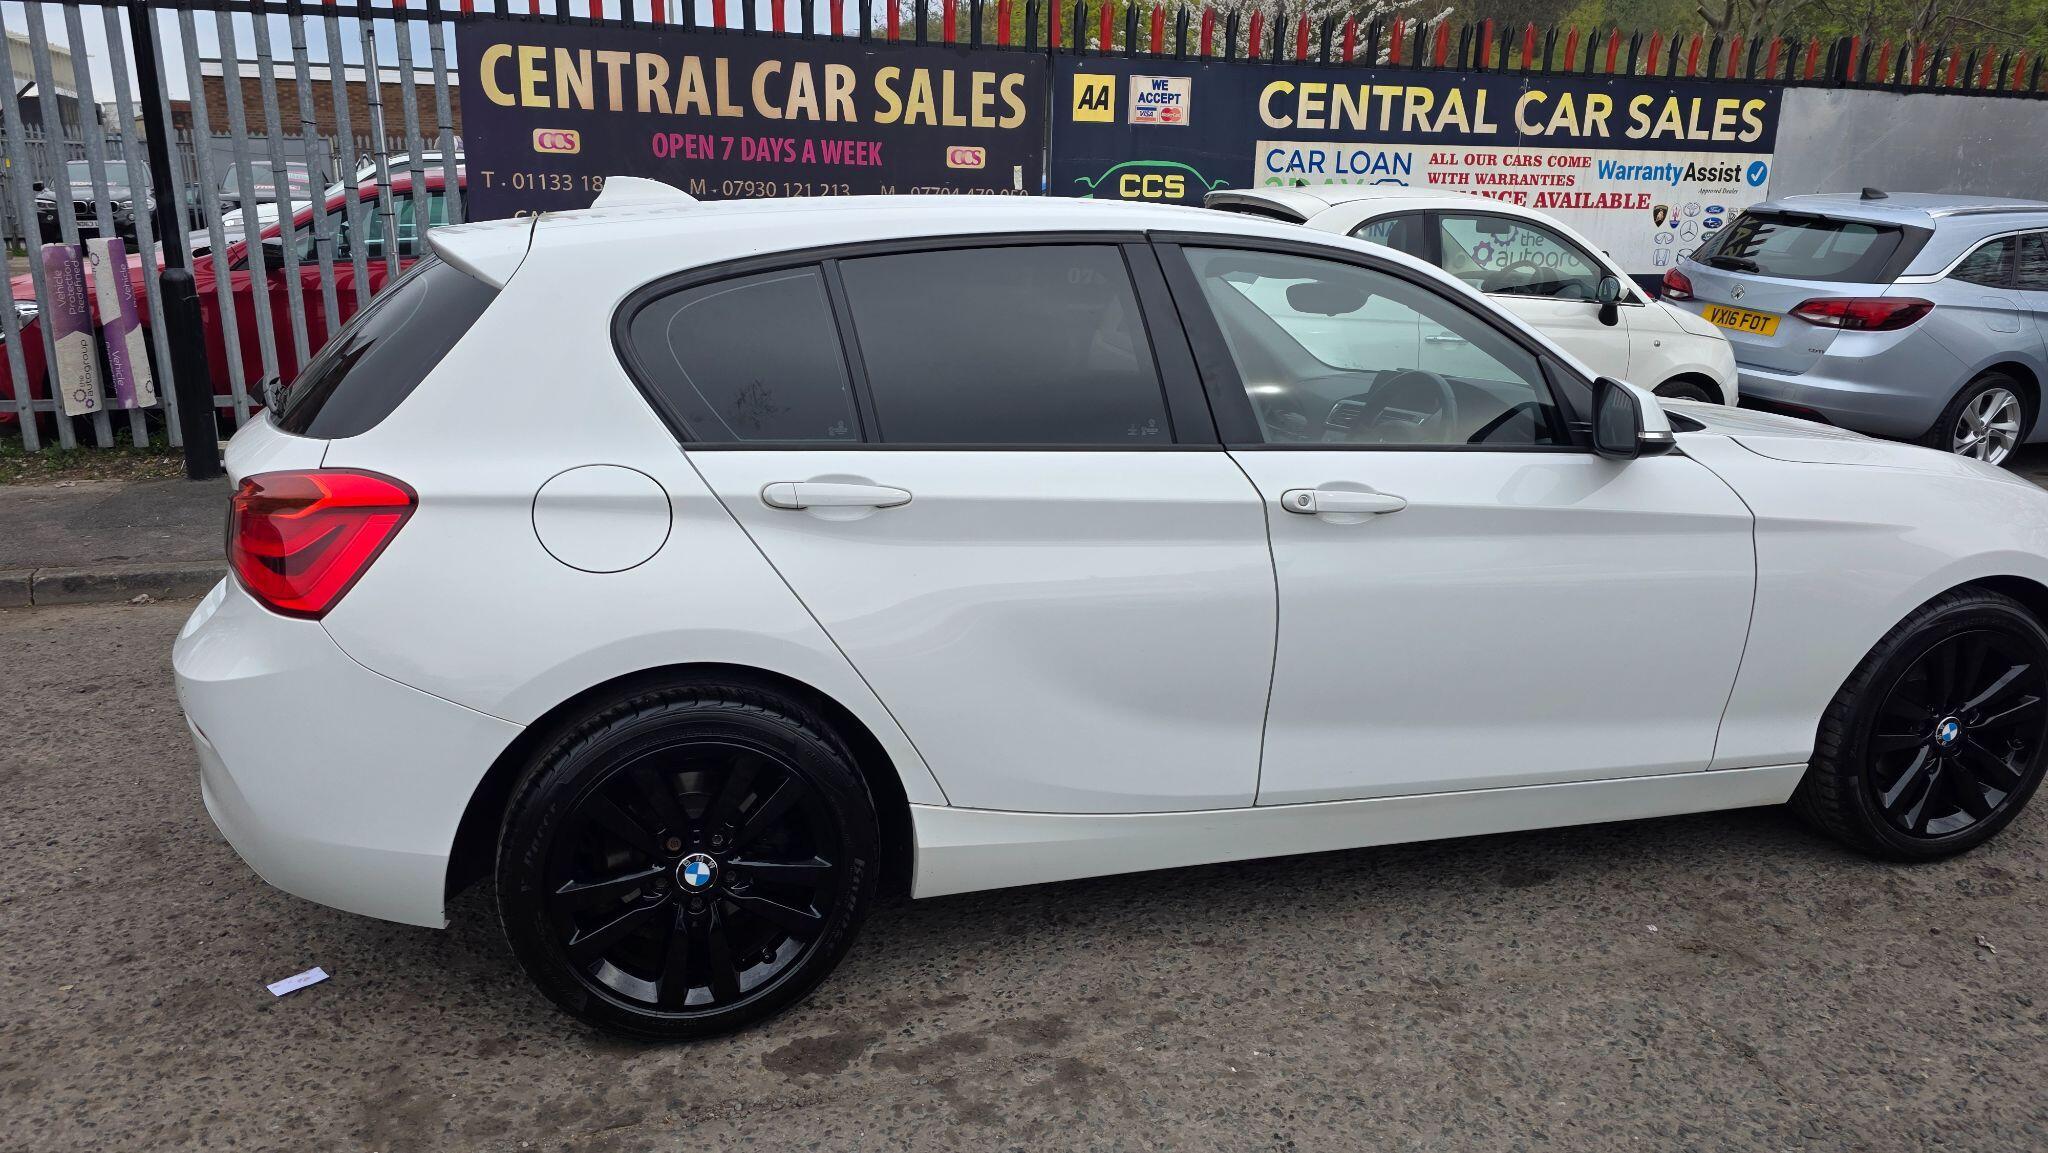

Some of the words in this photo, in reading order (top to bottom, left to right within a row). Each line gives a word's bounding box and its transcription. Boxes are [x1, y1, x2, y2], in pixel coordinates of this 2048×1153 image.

[480, 43, 744, 118] CENTRAL
[751, 59, 858, 123] CAR
[873, 66, 1027, 129] SALES
[1077, 84, 1110, 111] AA
[1151, 79, 1169, 91] WE
[1137, 91, 1182, 105] ACCEPT
[1258, 80, 1498, 134] CENTRAL
[1514, 90, 1611, 138] CAR
[1624, 94, 1767, 143] SALES
[538, 132, 576, 151] CCS
[651, 132, 715, 160] OPEN
[720, 136, 734, 161] 7
[741, 136, 797, 164] DAYS
[801, 139, 817, 164] A
[821, 139, 883, 166] WEEK
[950, 149, 982, 166] CCS
[1266, 148, 1326, 174] CAR
[1335, 150, 1413, 176] LOAN
[1429, 152, 1459, 166] ALL
[1463, 153, 1498, 167] OUR
[1502, 154, 1543, 168] CARS
[1547, 155, 1592, 168] COME
[512, 172, 573, 191] 01133
[581, 175, 605, 192] 18
[722, 180, 777, 198] 07930
[783, 181, 812, 198] 121
[819, 183, 850, 197] 213
[1119, 173, 1185, 199] CCS
[1427, 172, 1470, 185] WITH
[1474, 172, 1576, 187] WARRANTIES
[1532, 191, 1652, 210] AVAILABLE
[1520, 231, 1544, 247] the
[1495, 247, 1580, 268] autogro
[53, 270, 66, 308] Vehicle
[64, 260, 77, 315] Protection
[73, 260, 86, 313] Redefined
[119, 263, 133, 301] Vehicle
[1710, 308, 1740, 326] VX16
[1739, 313, 1771, 332] FOT
[80, 339, 93, 396] autogroup
[111, 350, 125, 386] Vehicle
